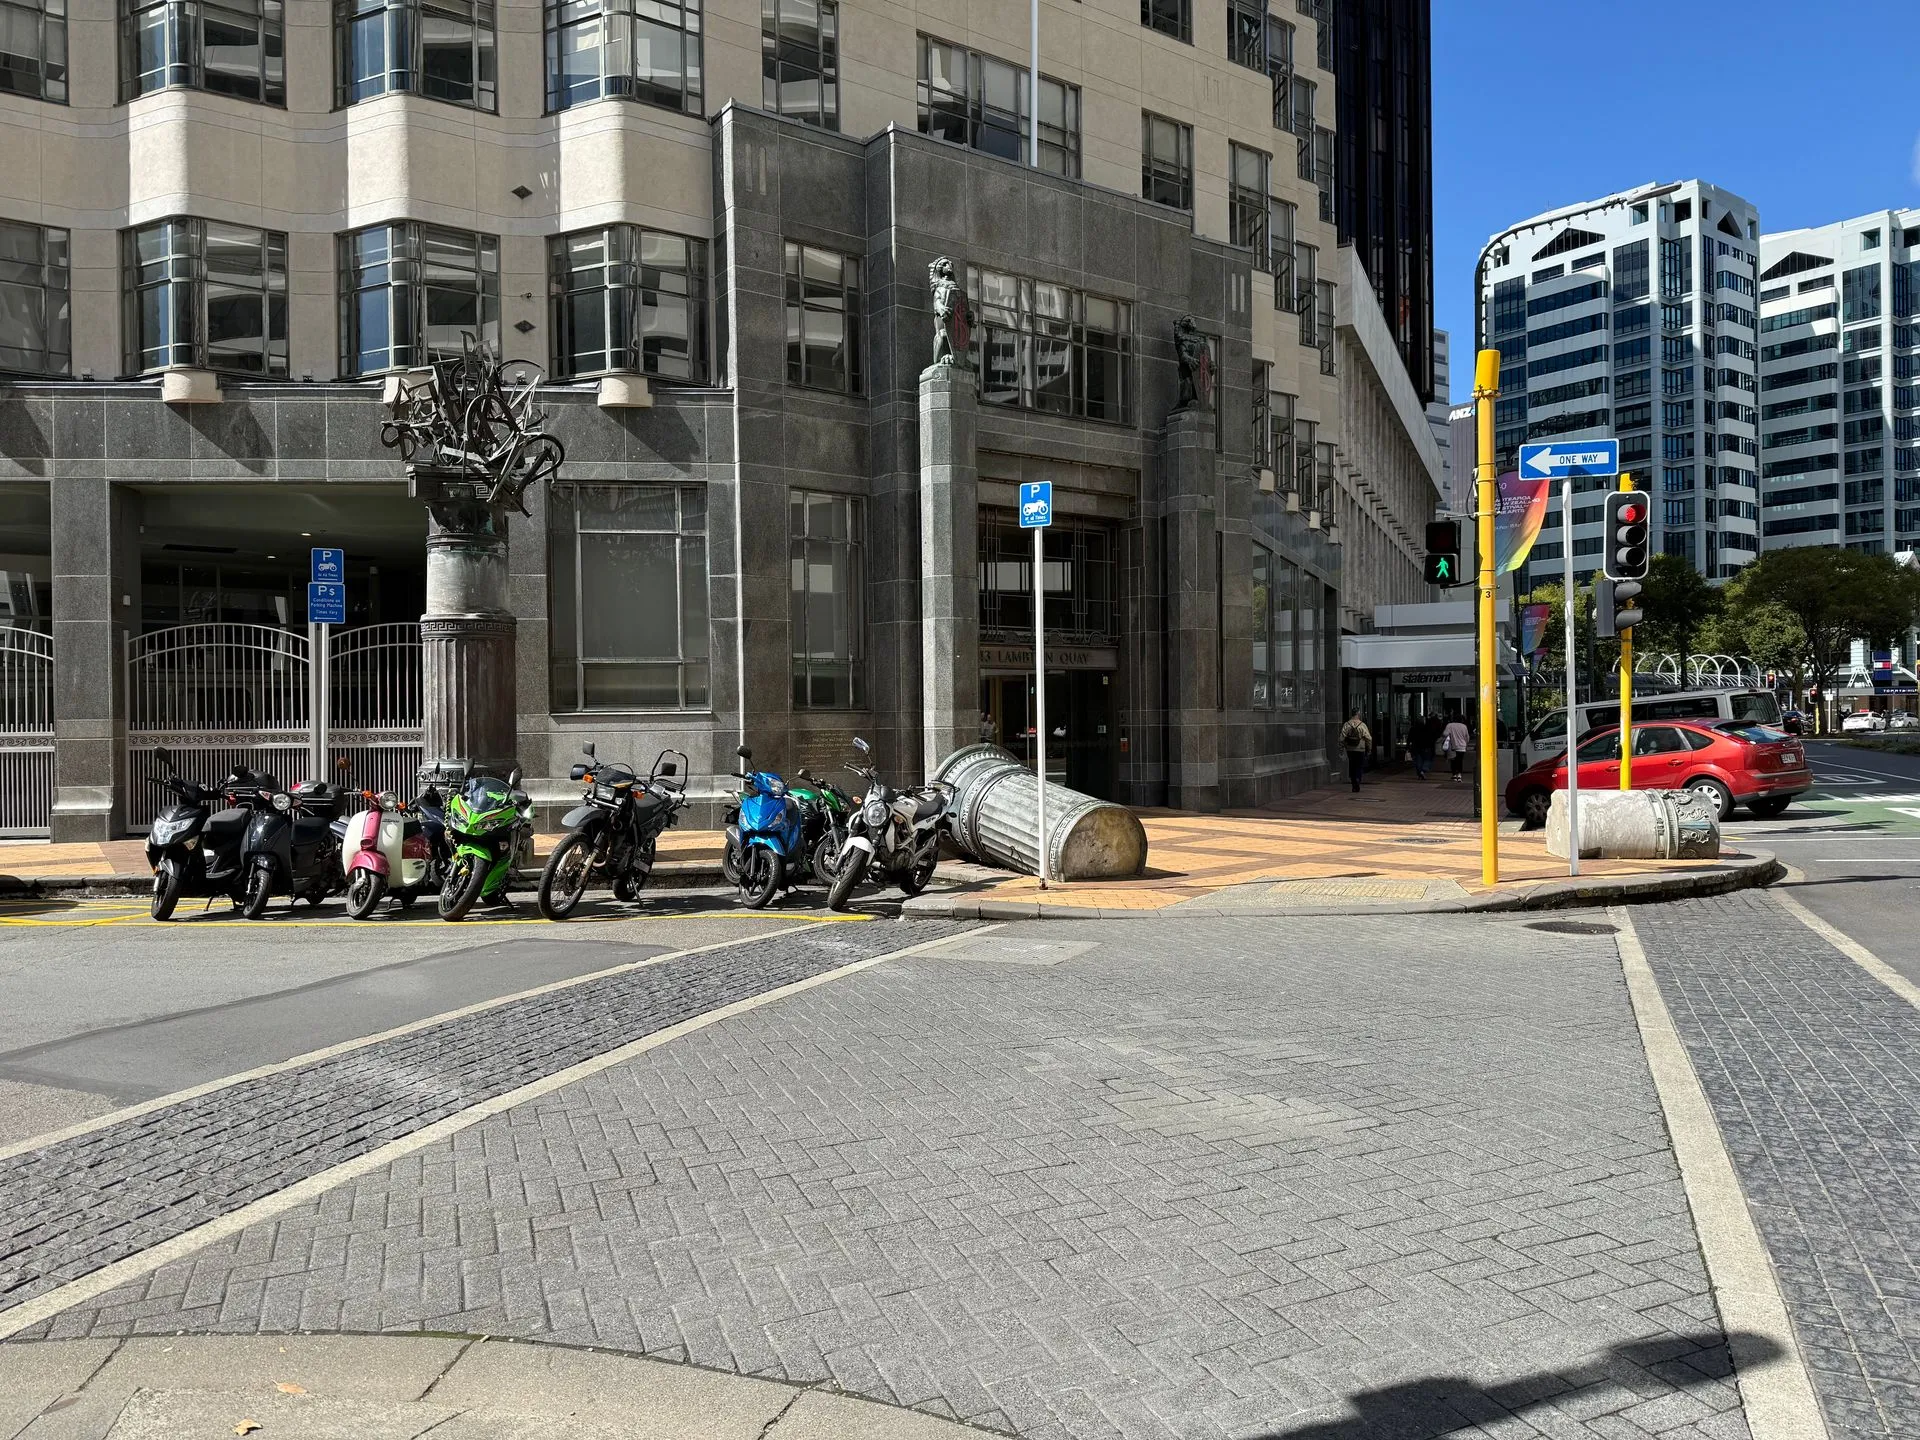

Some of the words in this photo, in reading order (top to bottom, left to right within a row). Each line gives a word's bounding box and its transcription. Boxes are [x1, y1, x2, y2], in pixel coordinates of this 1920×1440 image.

[1449, 407, 1472, 421] ANZ
[1560, 455, 1577, 465] ONE
[1582, 454, 1598, 463] WAY
[1031, 484, 1040, 498] P
[322, 550, 332, 561] P
[1485, 591, 1491, 599] 3
[1059, 651, 1088, 664] QUAY
[1402, 672, 1452, 683] statement
